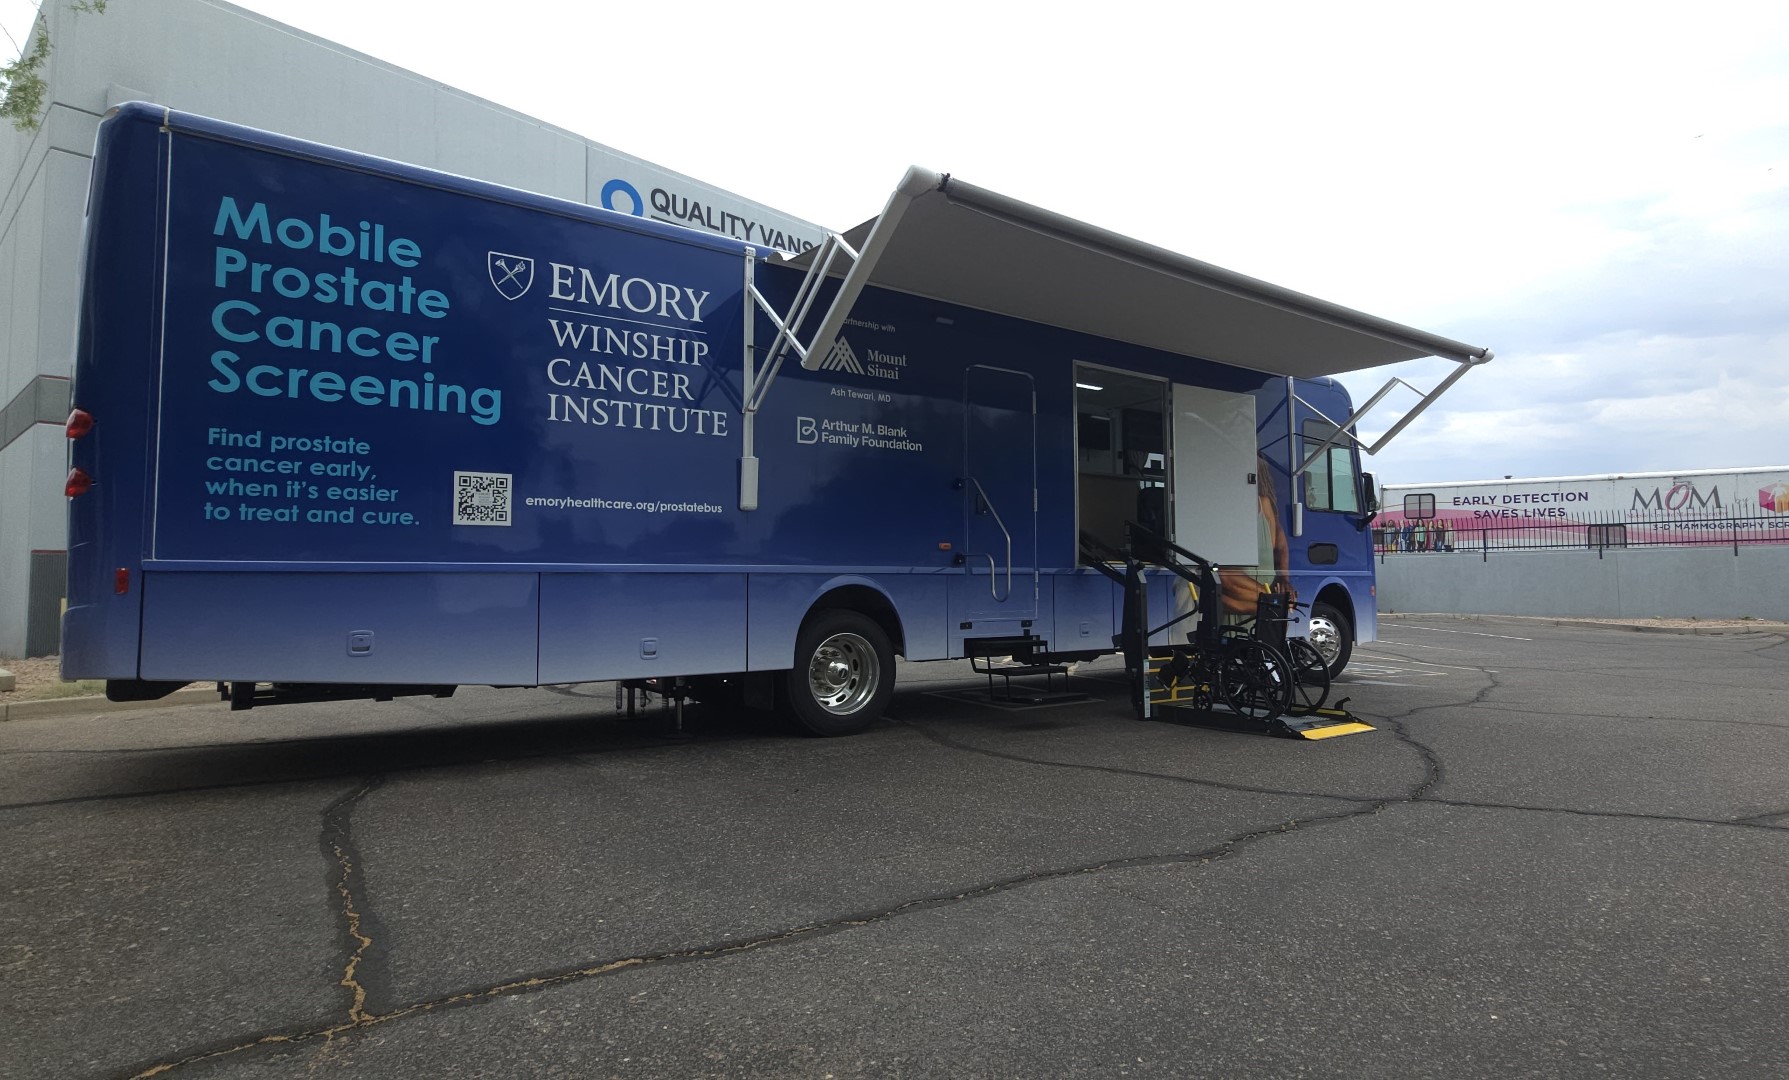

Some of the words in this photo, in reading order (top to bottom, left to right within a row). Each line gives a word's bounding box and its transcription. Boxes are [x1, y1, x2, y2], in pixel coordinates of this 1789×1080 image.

[650, 188, 756, 242] QUALITY
[213, 196, 422, 268] Mobile
[215, 246, 450, 319] Prostate
[549, 262, 710, 323] EMORY
[211, 300, 440, 364] Cancer
[842, 317, 880, 331] artnership
[881, 324, 896, 333] with
[548, 319, 709, 367] WINSHIP
[867, 349, 908, 367] Mount
[547, 358, 695, 401] CANCER
[867, 364, 900, 380] Sinai
[208, 350, 501, 426] Screening
[830, 387, 846, 397] Ash
[877, 393, 892, 403] MD
[547, 393, 728, 437] INSTITUTE
[821, 419, 860, 433] Arthur
[861, 423, 875, 435] M.
[877, 425, 908, 438] Blank
[208, 427, 262, 448] Find
[270, 435, 371, 455] prostate
[821, 432, 860, 448] Family
[861, 436, 923, 452] Foundation
[206, 456, 302, 474] cancer
[309, 460, 377, 481] early,
[205, 478, 278, 497] when
[286, 480, 319, 499] it’s
[326, 484, 399, 502] easier
[1453, 495, 1498, 506] EARLY
[1502, 492, 1589, 504] DETECTION
[1630, 483, 1727, 511] MOM
[204, 502, 231, 520] to
[239, 503, 300, 522] treat
[306, 507, 354, 524] and
[362, 511, 420, 525] cure.
[525, 496, 723, 513] emoryhealthcare.org/prostatebus
[1473, 508, 1519, 519] SAVES
[1524, 507, 1566, 518] LIVES
[1653, 523, 1671, 531] 3-D
[1674, 521, 1764, 531] MAMMOGRAPHY
